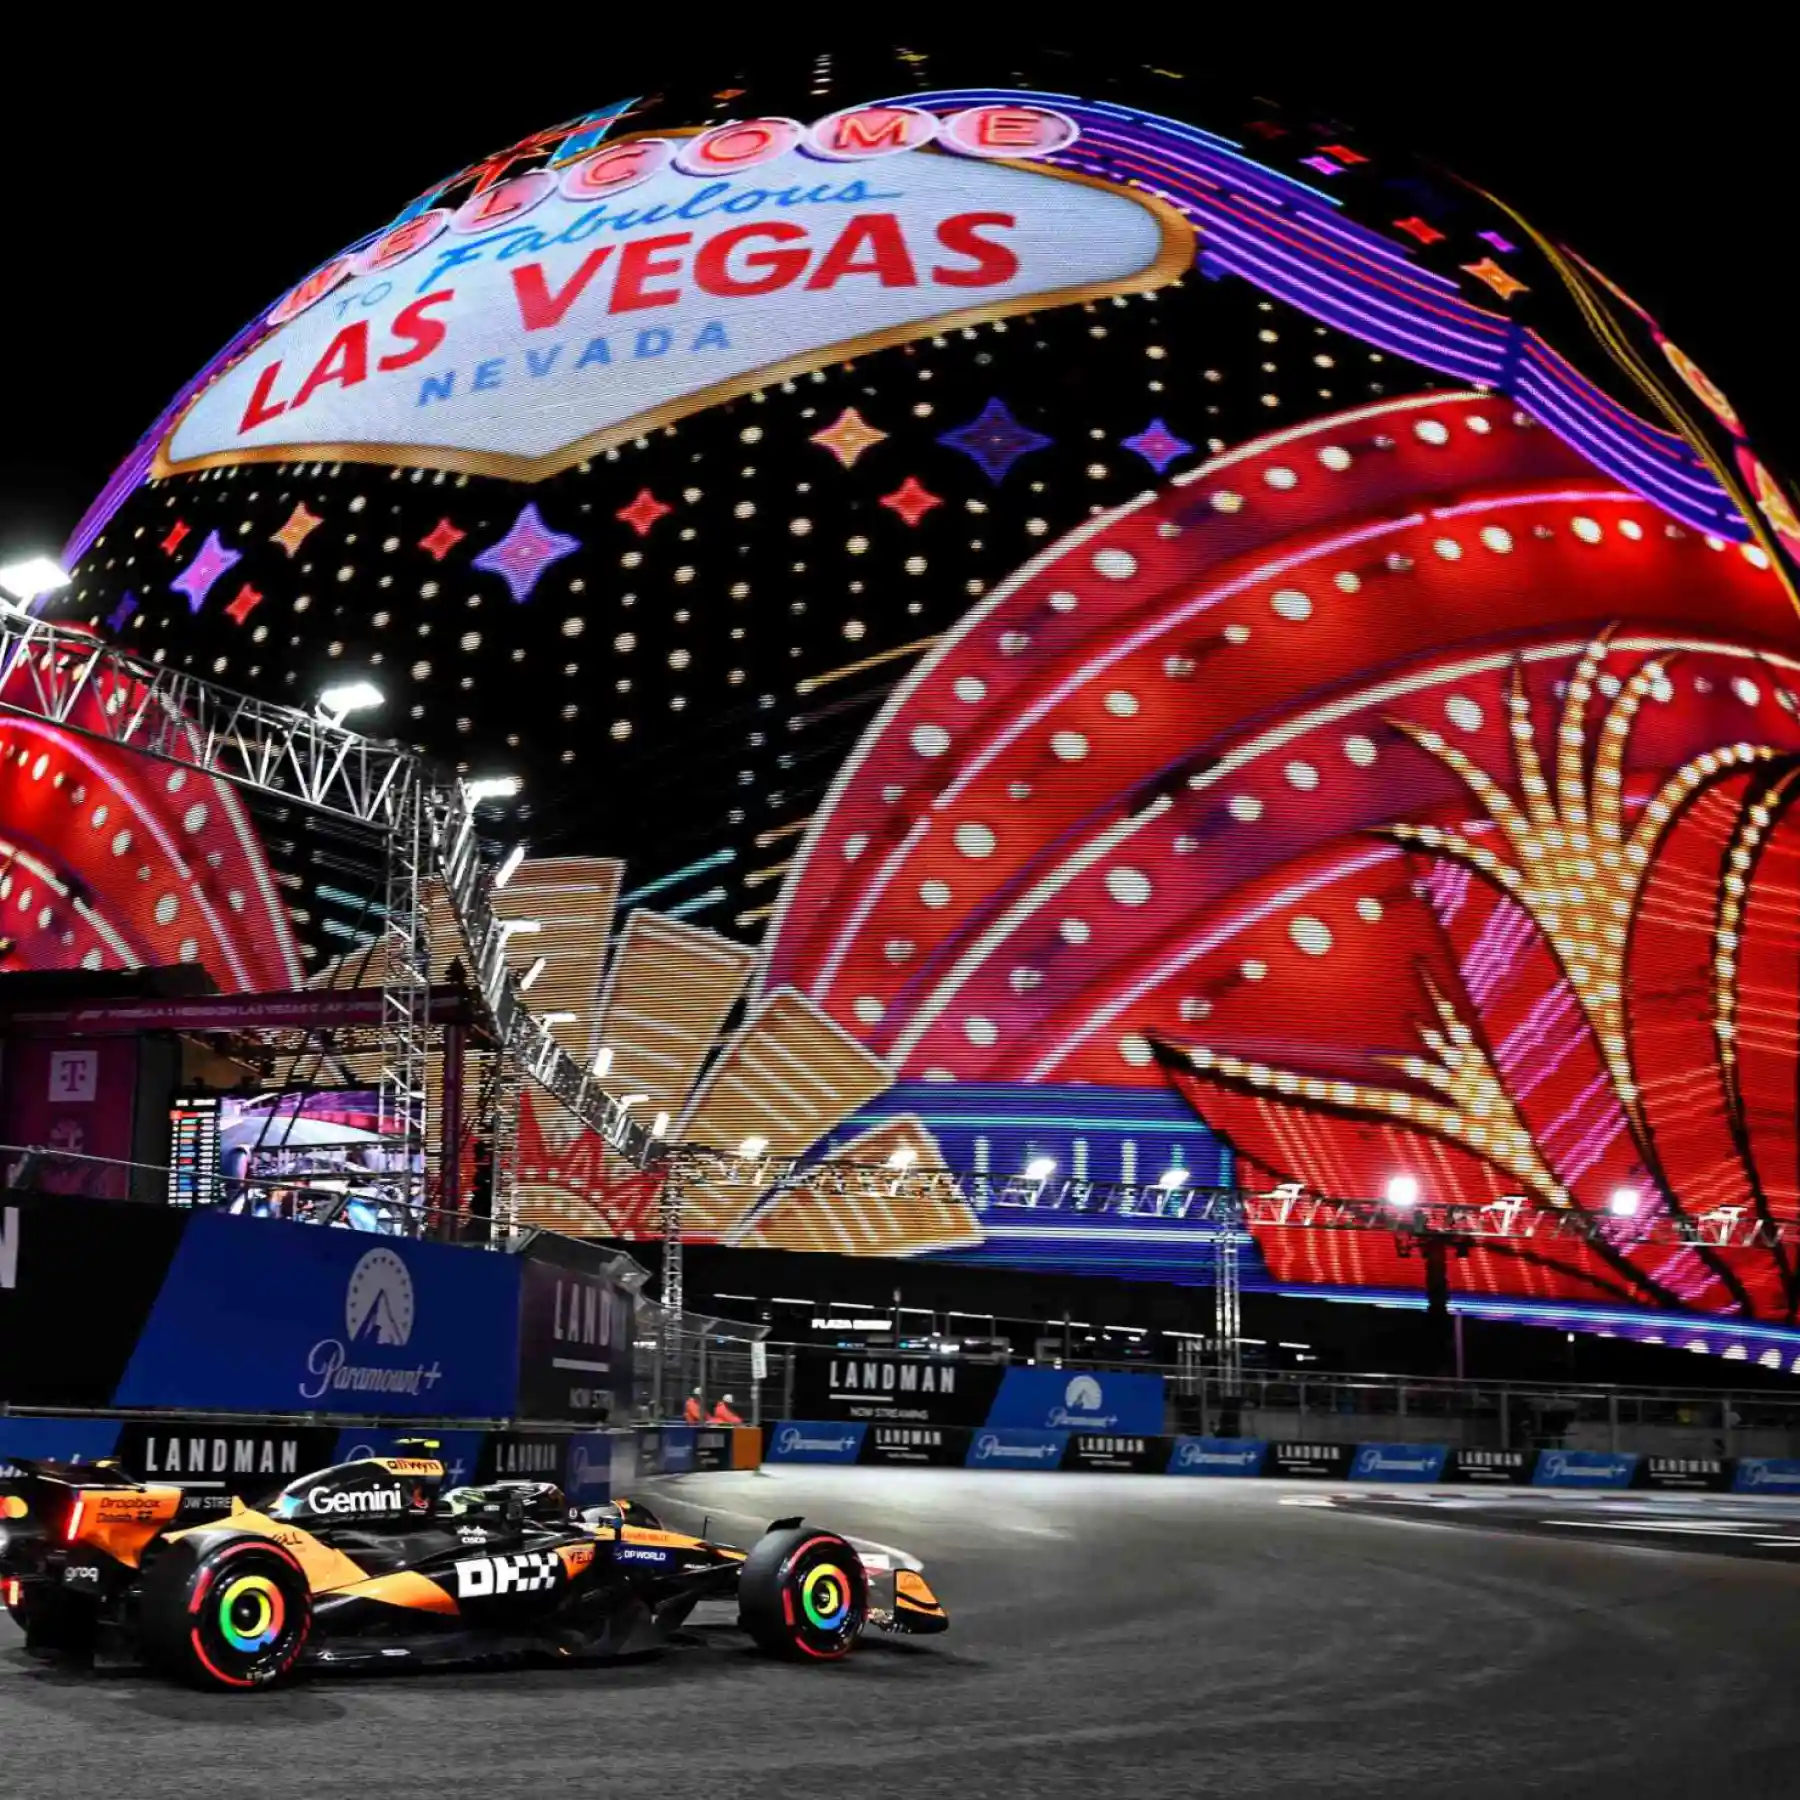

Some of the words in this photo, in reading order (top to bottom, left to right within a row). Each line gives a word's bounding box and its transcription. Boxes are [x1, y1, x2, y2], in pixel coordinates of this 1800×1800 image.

[286, 110, 1042, 310] WELCOME
[334, 280, 392, 319] TO
[416, 178, 904, 293] Fabulous
[237, 289, 455, 435] LAS
[511, 212, 1018, 331] VEGAS
[415, 321, 730, 407] NEVADA
[299, 1338, 442, 1398] Paramount+
[829, 1360, 955, 1393] LANDMAN
[875, 1429, 942, 1446] LANDMAN
[1078, 1437, 1146, 1453] LANDMAN
[146, 1437, 297, 1473] LANDMAN
[1277, 1444, 1340, 1460] LANDMAN
[1457, 1451, 1523, 1466] LANDMAN
[1649, 1457, 1721, 1474] LANDMAN
[101, 1497, 160, 1510] Dropbox
[183, 1496, 200, 1508] OW
[203, 1496, 232, 1509] STRE
[308, 1482, 401, 1514] Gemini
[636, 1551, 667, 1561] WORLD
[65, 1566, 99, 1582] groq
[455, 1552, 558, 1598] OKX
